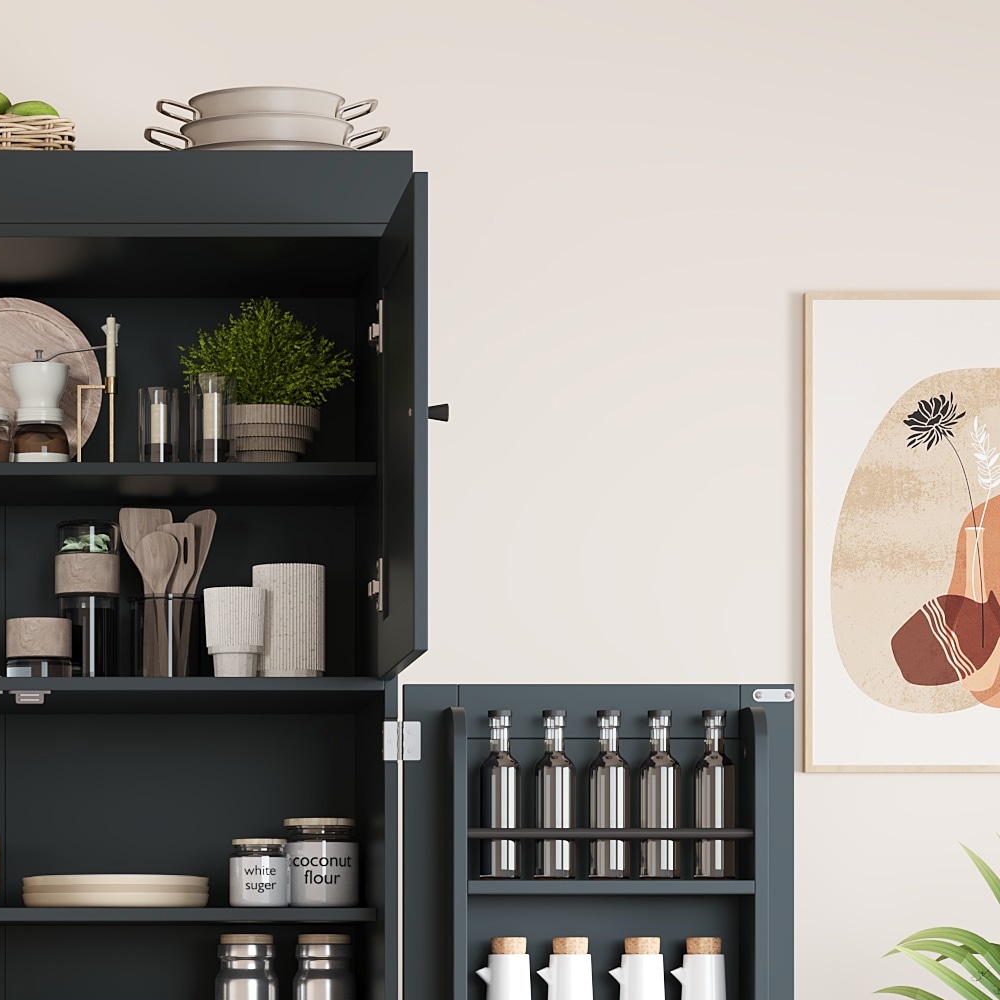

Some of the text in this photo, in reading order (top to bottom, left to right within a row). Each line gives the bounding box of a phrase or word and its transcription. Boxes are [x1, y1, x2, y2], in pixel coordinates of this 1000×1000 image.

[292, 856, 352, 867] coconut
[244, 865, 277, 876] white
[304, 869, 341, 884] flour
[245, 882, 277, 893] suger
